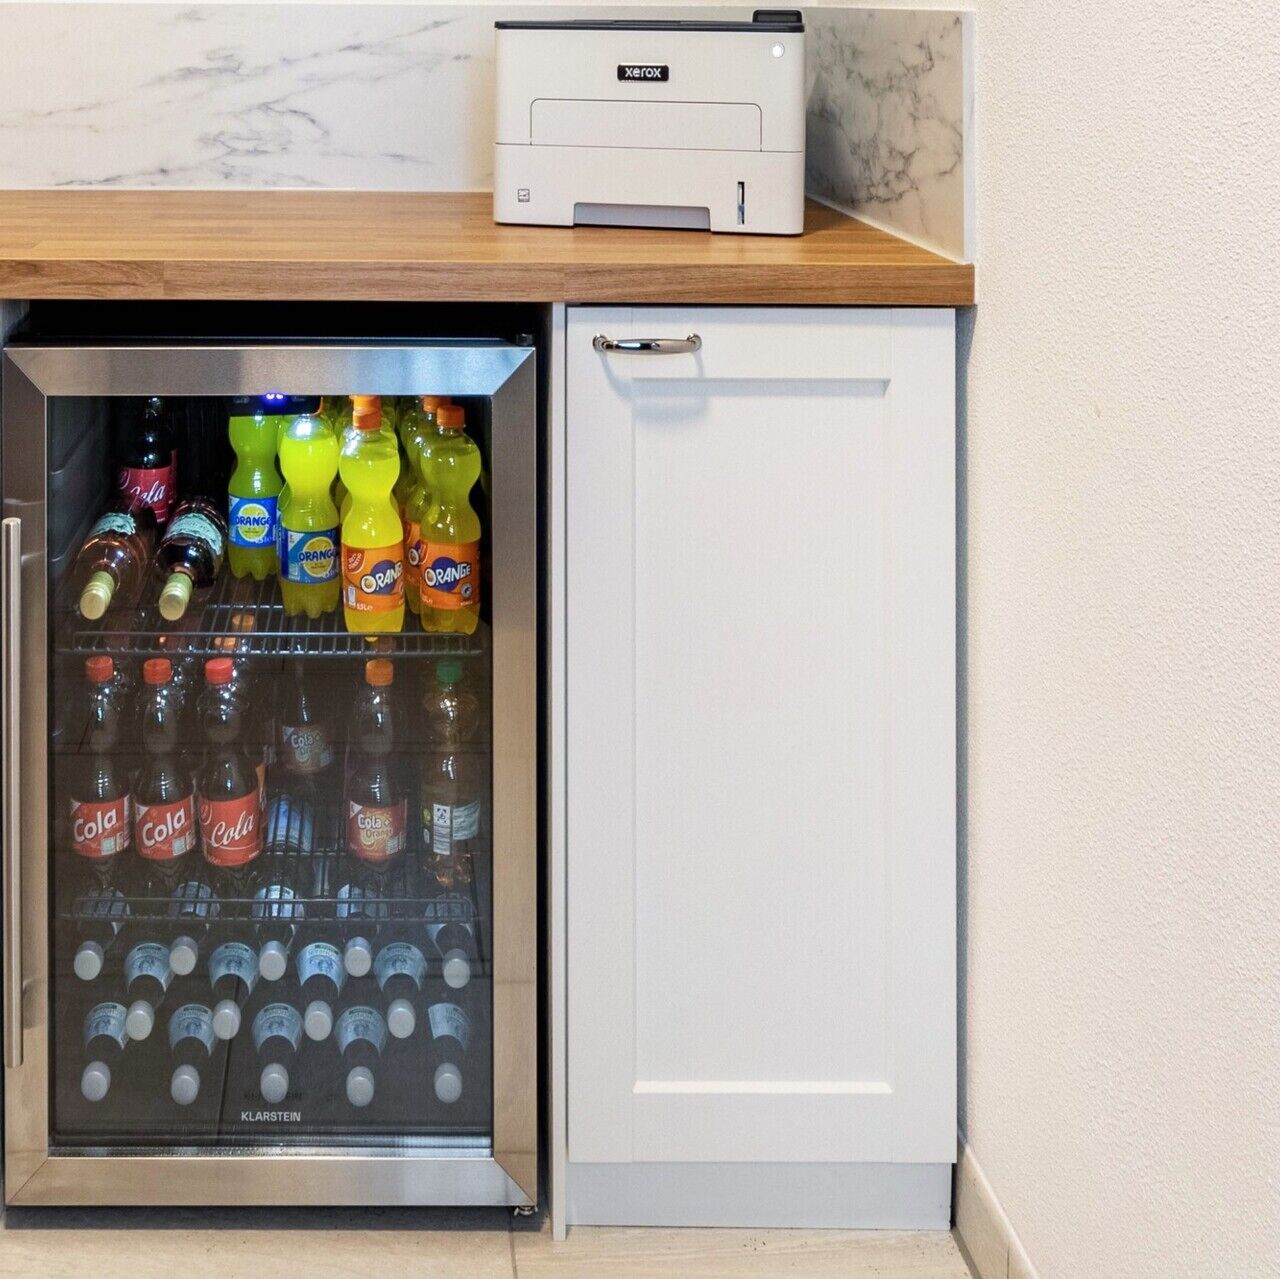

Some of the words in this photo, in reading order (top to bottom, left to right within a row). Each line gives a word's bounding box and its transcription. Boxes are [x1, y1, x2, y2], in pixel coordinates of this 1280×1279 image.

[624, 67, 662, 78] xerox
[424, 563, 471, 586] ORANGE
[291, 734, 314, 748] Cola
[73, 808, 117, 842] Cola
[142, 807, 186, 847] Cola
[211, 810, 254, 848] Cola
[357, 814, 382, 829] Cola
[241, 1111, 302, 1122] KLARSTEIN
